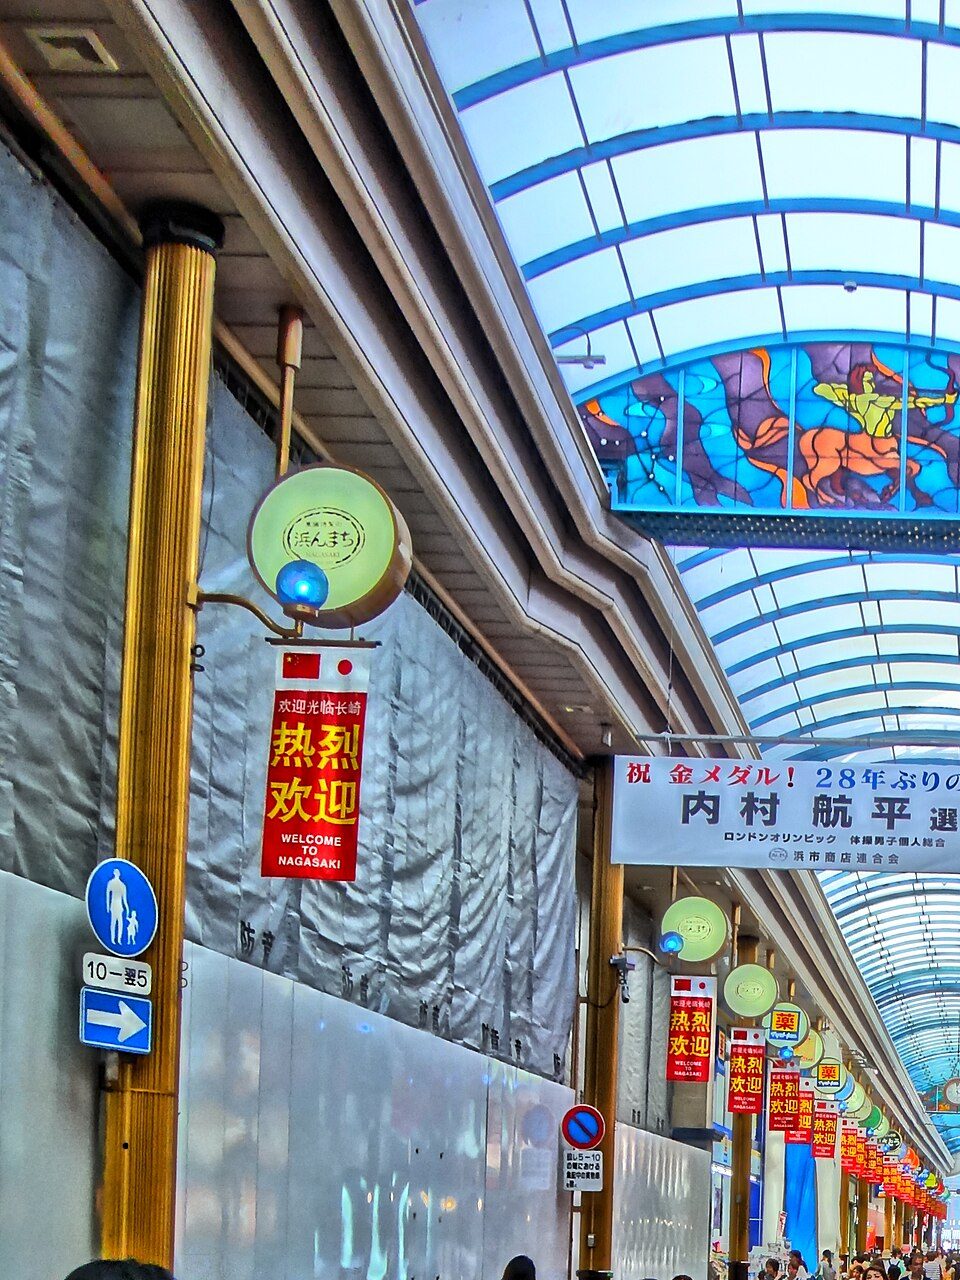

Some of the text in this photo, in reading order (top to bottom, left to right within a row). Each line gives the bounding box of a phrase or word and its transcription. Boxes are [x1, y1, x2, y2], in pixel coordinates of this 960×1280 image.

[294, 530, 354, 548] 浜んまち
[278, 698, 361, 716] 欢迎光临长崎
[271, 722, 359, 770] 热烈
[267, 778, 357, 824] 欢迎
[281, 833, 342, 848] WELCOME
[302, 846, 318, 857] TO
[278, 856, 341, 870] NAGASAKI
[670, 1010, 710, 1033] 热烈
[775, 1013, 795, 1030] 薬
[669, 1035, 709, 1057] 欢迎
[730, 1056, 762, 1074] 热烈
[730, 1076, 762, 1094] 欢迎
[771, 1082, 798, 1097] 热烈
[770, 1100, 798, 1114] 欢迎
